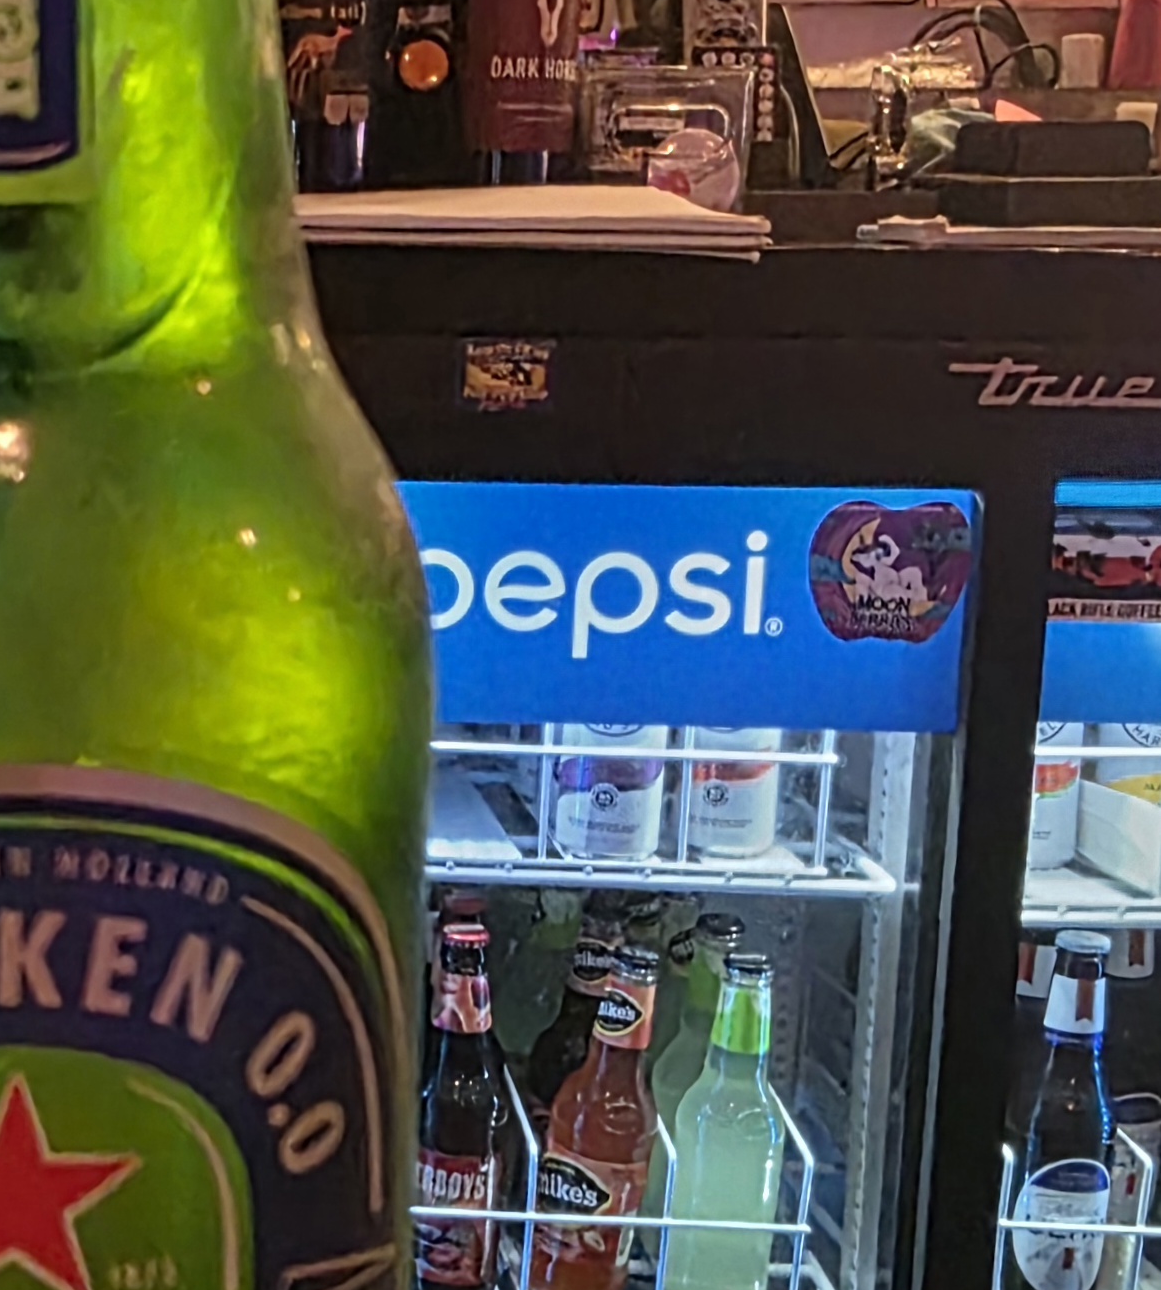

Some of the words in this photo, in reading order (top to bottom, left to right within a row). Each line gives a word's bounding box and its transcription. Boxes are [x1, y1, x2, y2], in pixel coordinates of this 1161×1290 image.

[490, 56, 539, 79] DARK
[858, 594, 911, 612] MOON
[1053, 602, 1075, 617] ACK
[246, 1009, 348, 1176] 0.0
